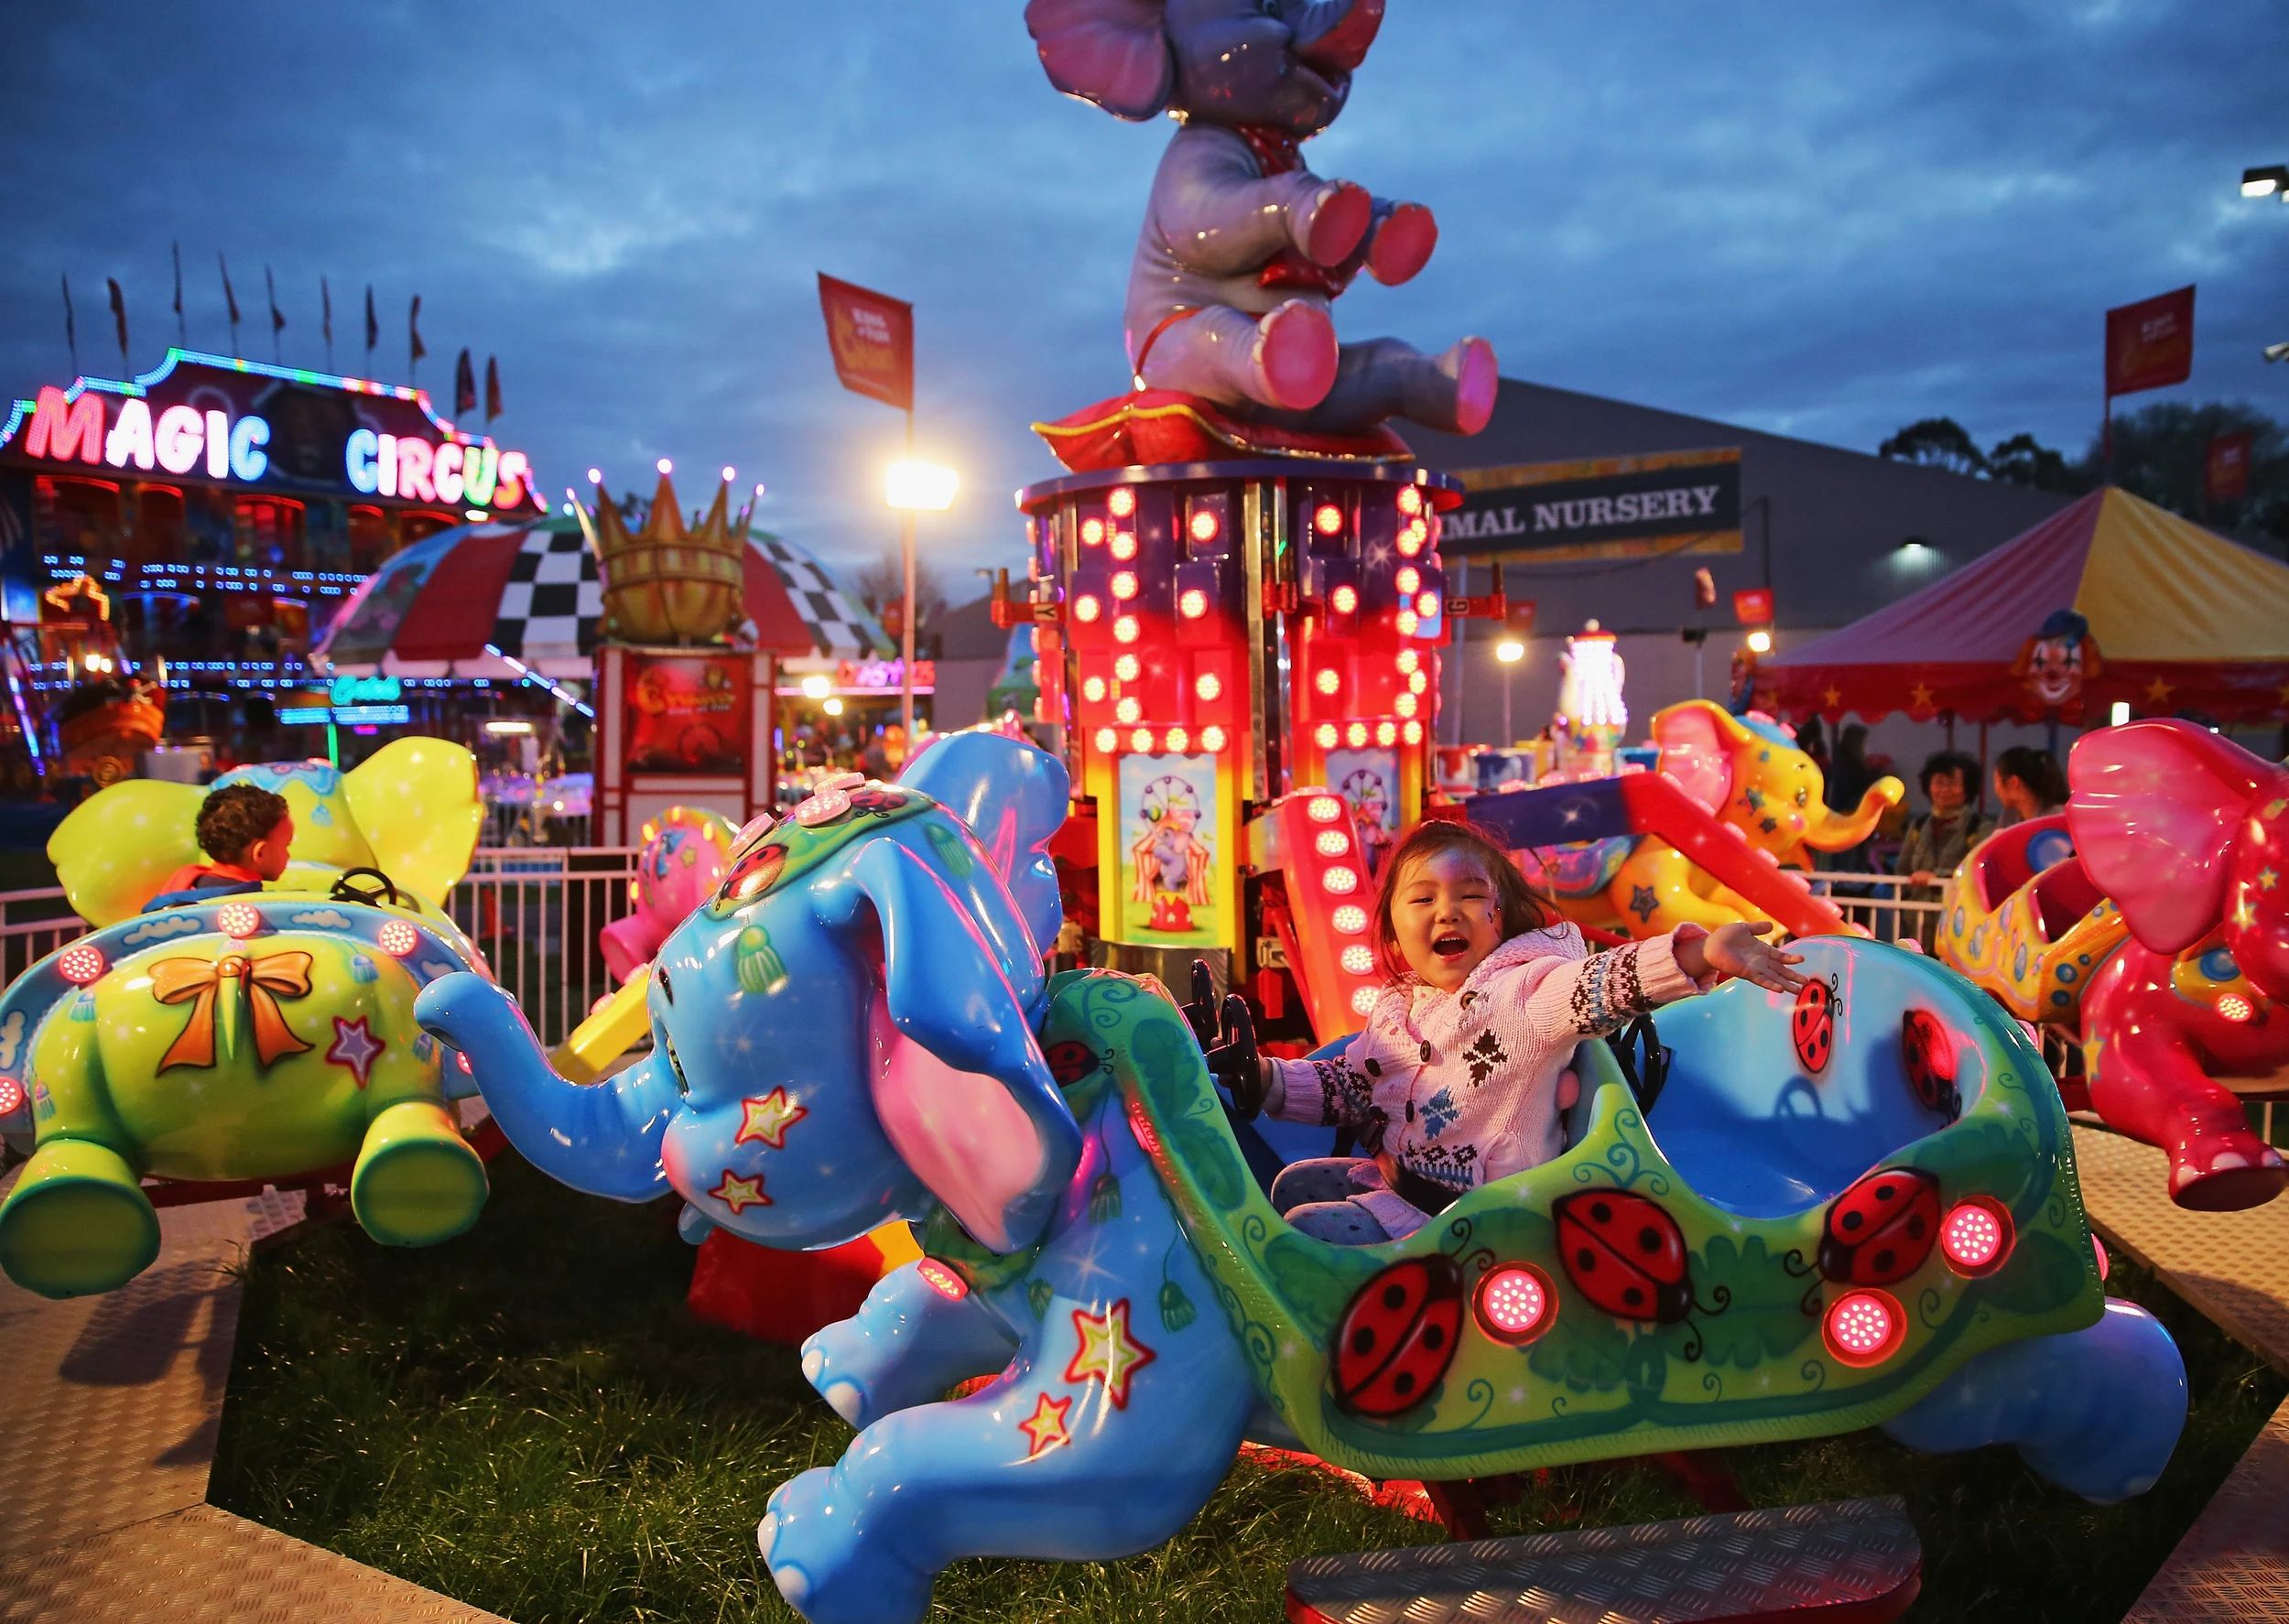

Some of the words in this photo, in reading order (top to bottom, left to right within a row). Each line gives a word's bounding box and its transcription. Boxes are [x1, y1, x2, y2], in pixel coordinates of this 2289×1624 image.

[25, 385, 271, 482] MAGIC
[346, 428, 527, 510] CIRCUS
[1533, 485, 1719, 532] NURSERY
